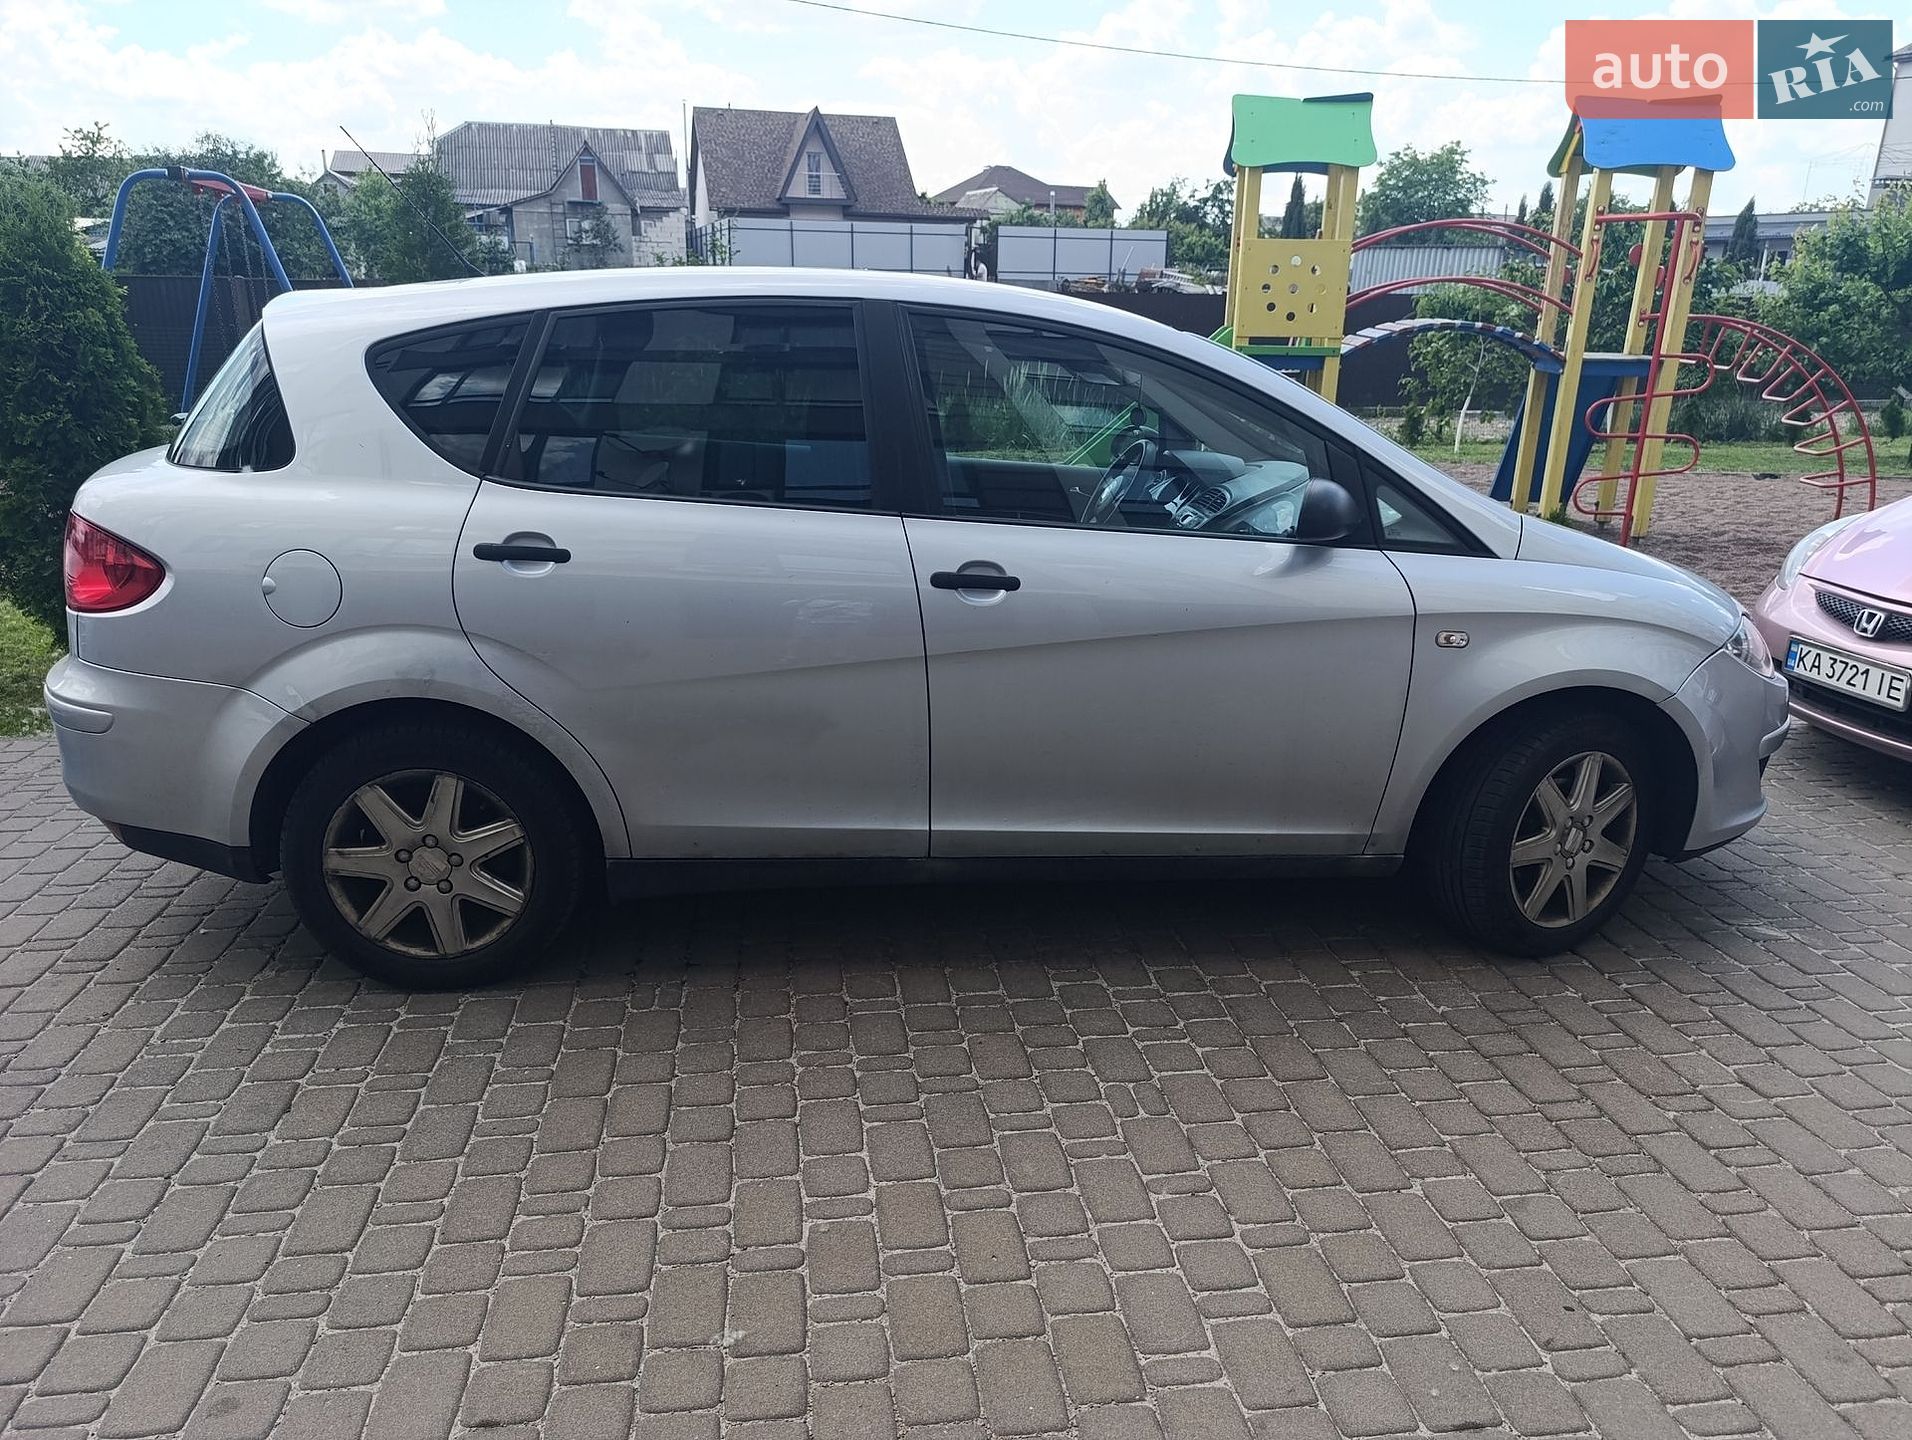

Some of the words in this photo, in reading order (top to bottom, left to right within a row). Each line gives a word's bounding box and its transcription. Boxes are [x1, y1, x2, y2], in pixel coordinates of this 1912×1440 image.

[1796, 647, 1821, 676] KA
[1825, 656, 1870, 691] 3721
[1877, 672, 1904, 702] IE
